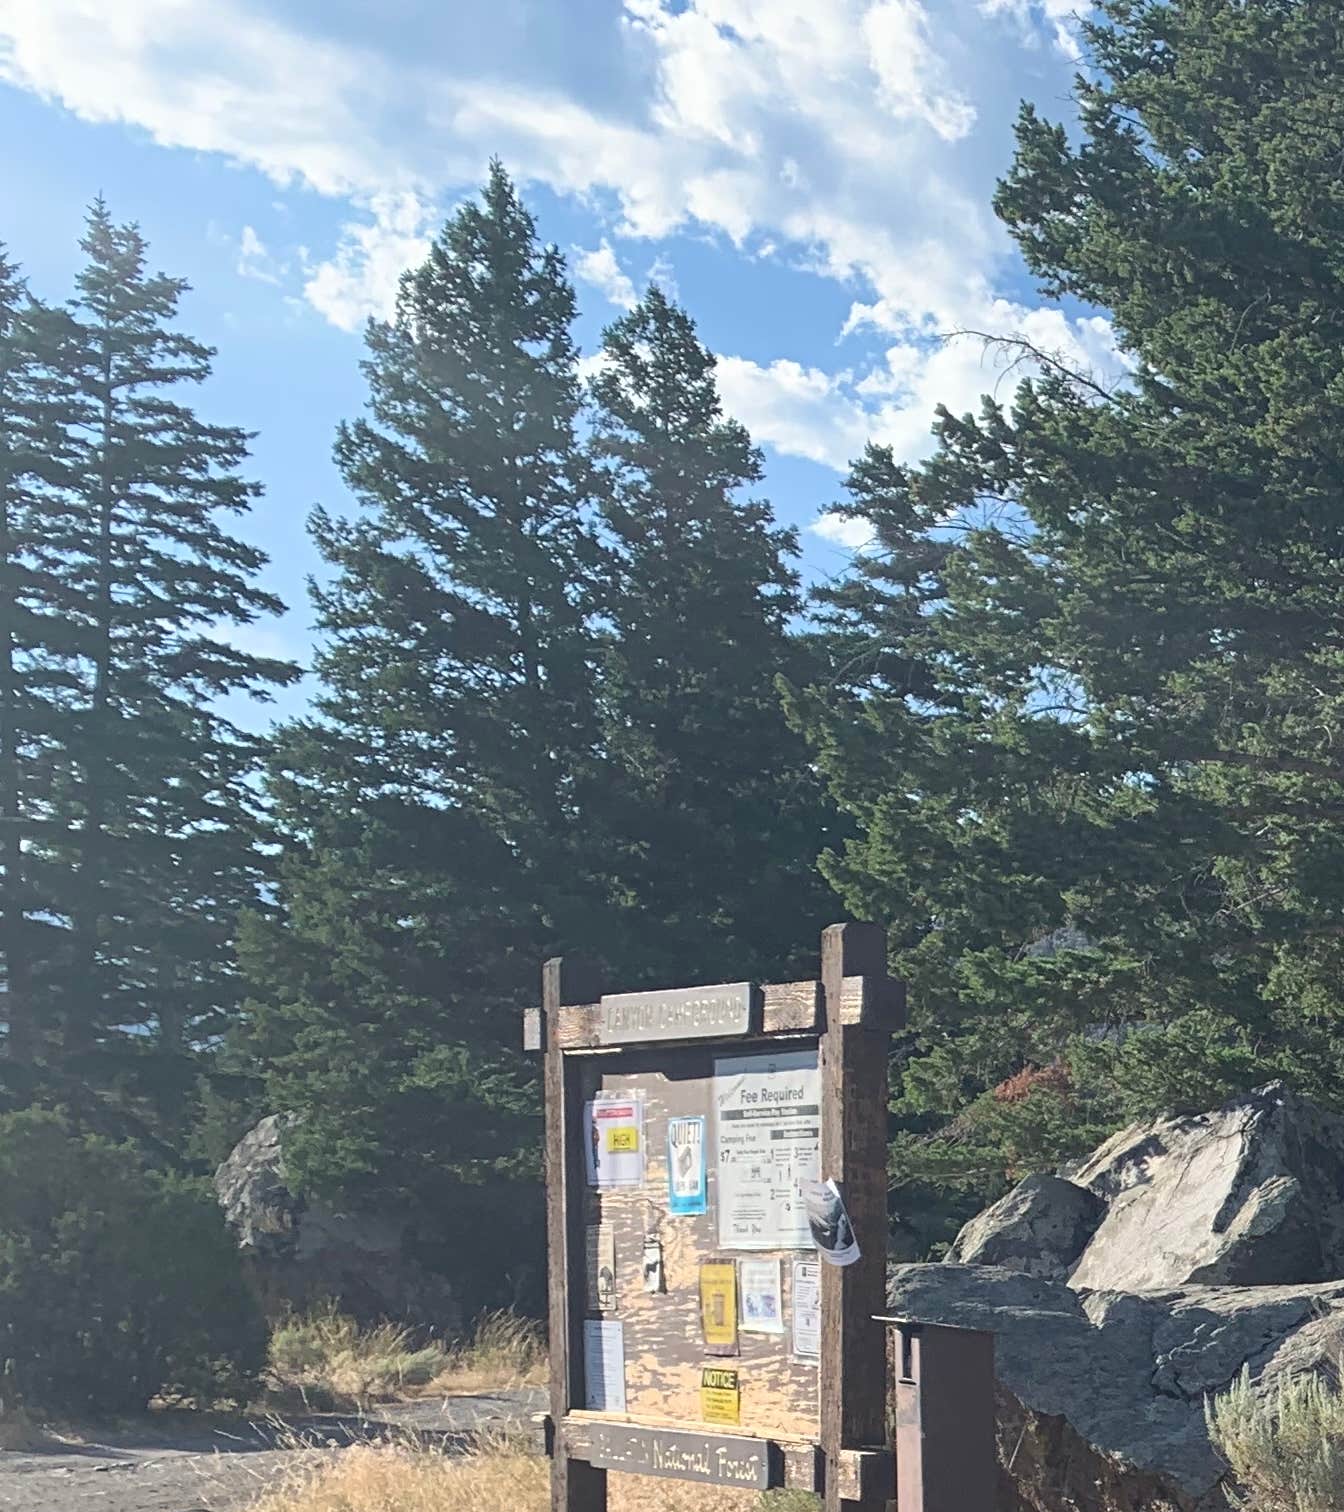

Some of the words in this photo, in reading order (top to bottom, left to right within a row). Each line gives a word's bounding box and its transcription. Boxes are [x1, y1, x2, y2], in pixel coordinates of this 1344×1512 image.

[740, 1090, 758, 1104] Fee
[761, 1085, 804, 1105] Required
[671, 1121, 700, 1148] QUIET!
[703, 1370, 735, 1388] NOTICE
[653, 1439, 711, 1475] National
[715, 1446, 758, 1482] Forest
